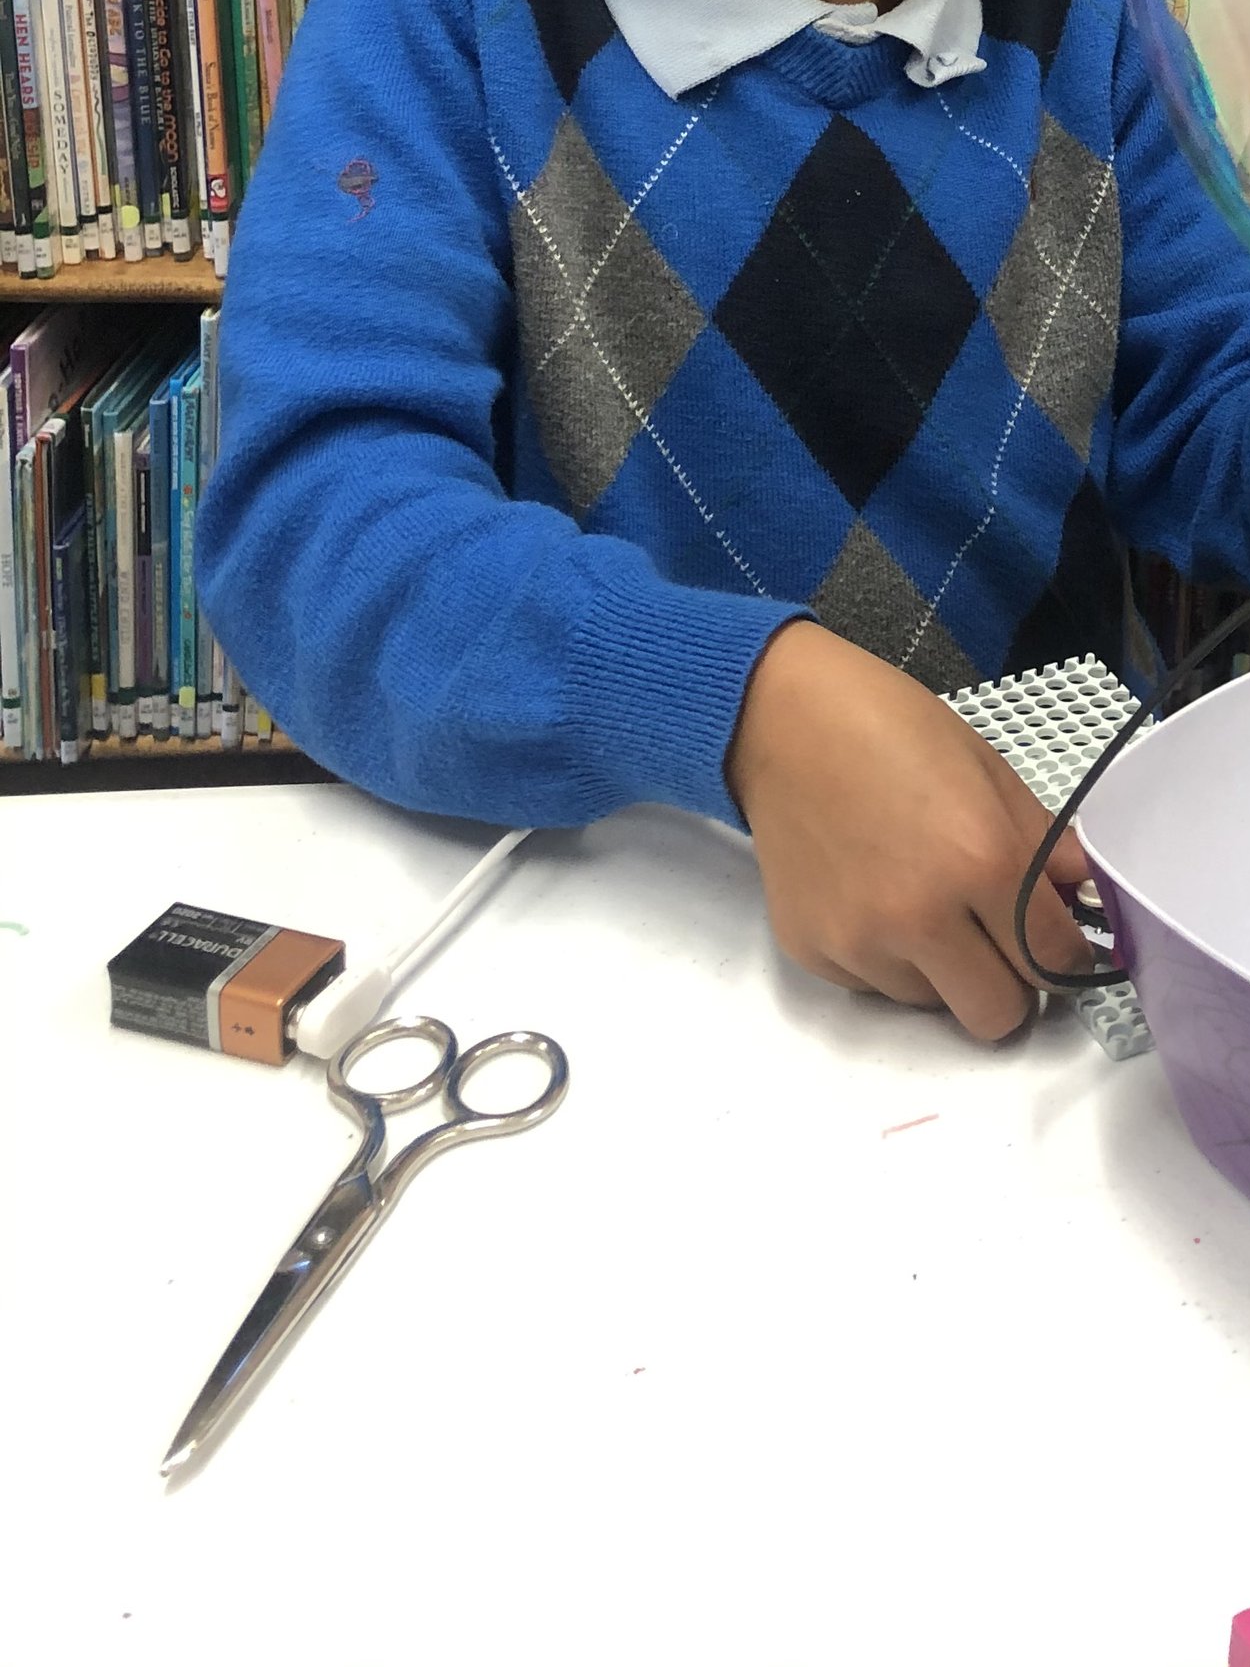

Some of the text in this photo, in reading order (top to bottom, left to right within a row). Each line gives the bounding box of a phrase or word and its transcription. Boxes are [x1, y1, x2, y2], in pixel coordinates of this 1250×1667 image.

[106, 9, 118, 36] ABC
[134, 20, 144, 43] TO
[15, 14, 35, 105] HEN HEARS
[135, 48, 146, 79] THE
[138, 85, 150, 125] BLUE
[53, 90, 69, 174] SOMEDAY
[155, 930, 244, 960] DURACELL
